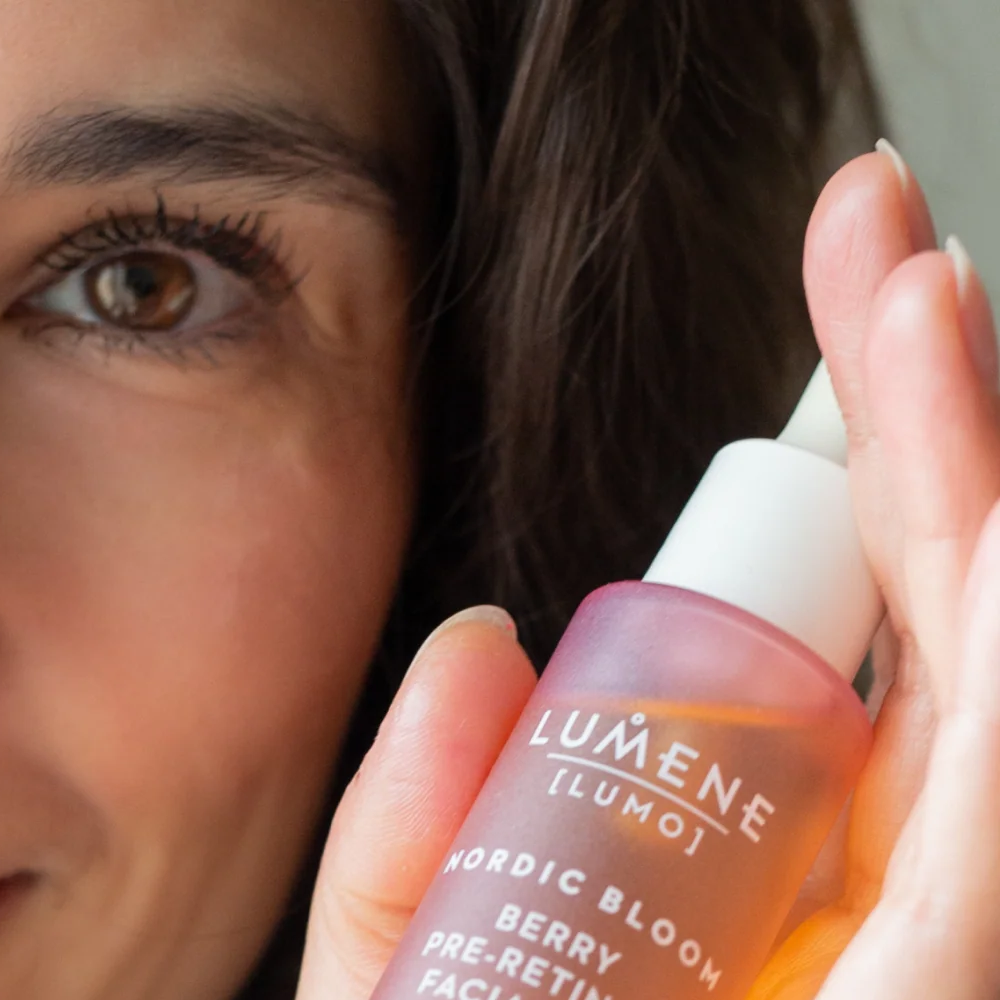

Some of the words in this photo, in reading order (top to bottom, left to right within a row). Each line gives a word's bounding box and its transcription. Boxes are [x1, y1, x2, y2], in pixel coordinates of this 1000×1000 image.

[548, 768, 705, 856] [LUMO]
[443, 847, 586, 896] NORDIC
[598, 885, 722, 991] BLOOM
[495, 903, 622, 975] BERRY
